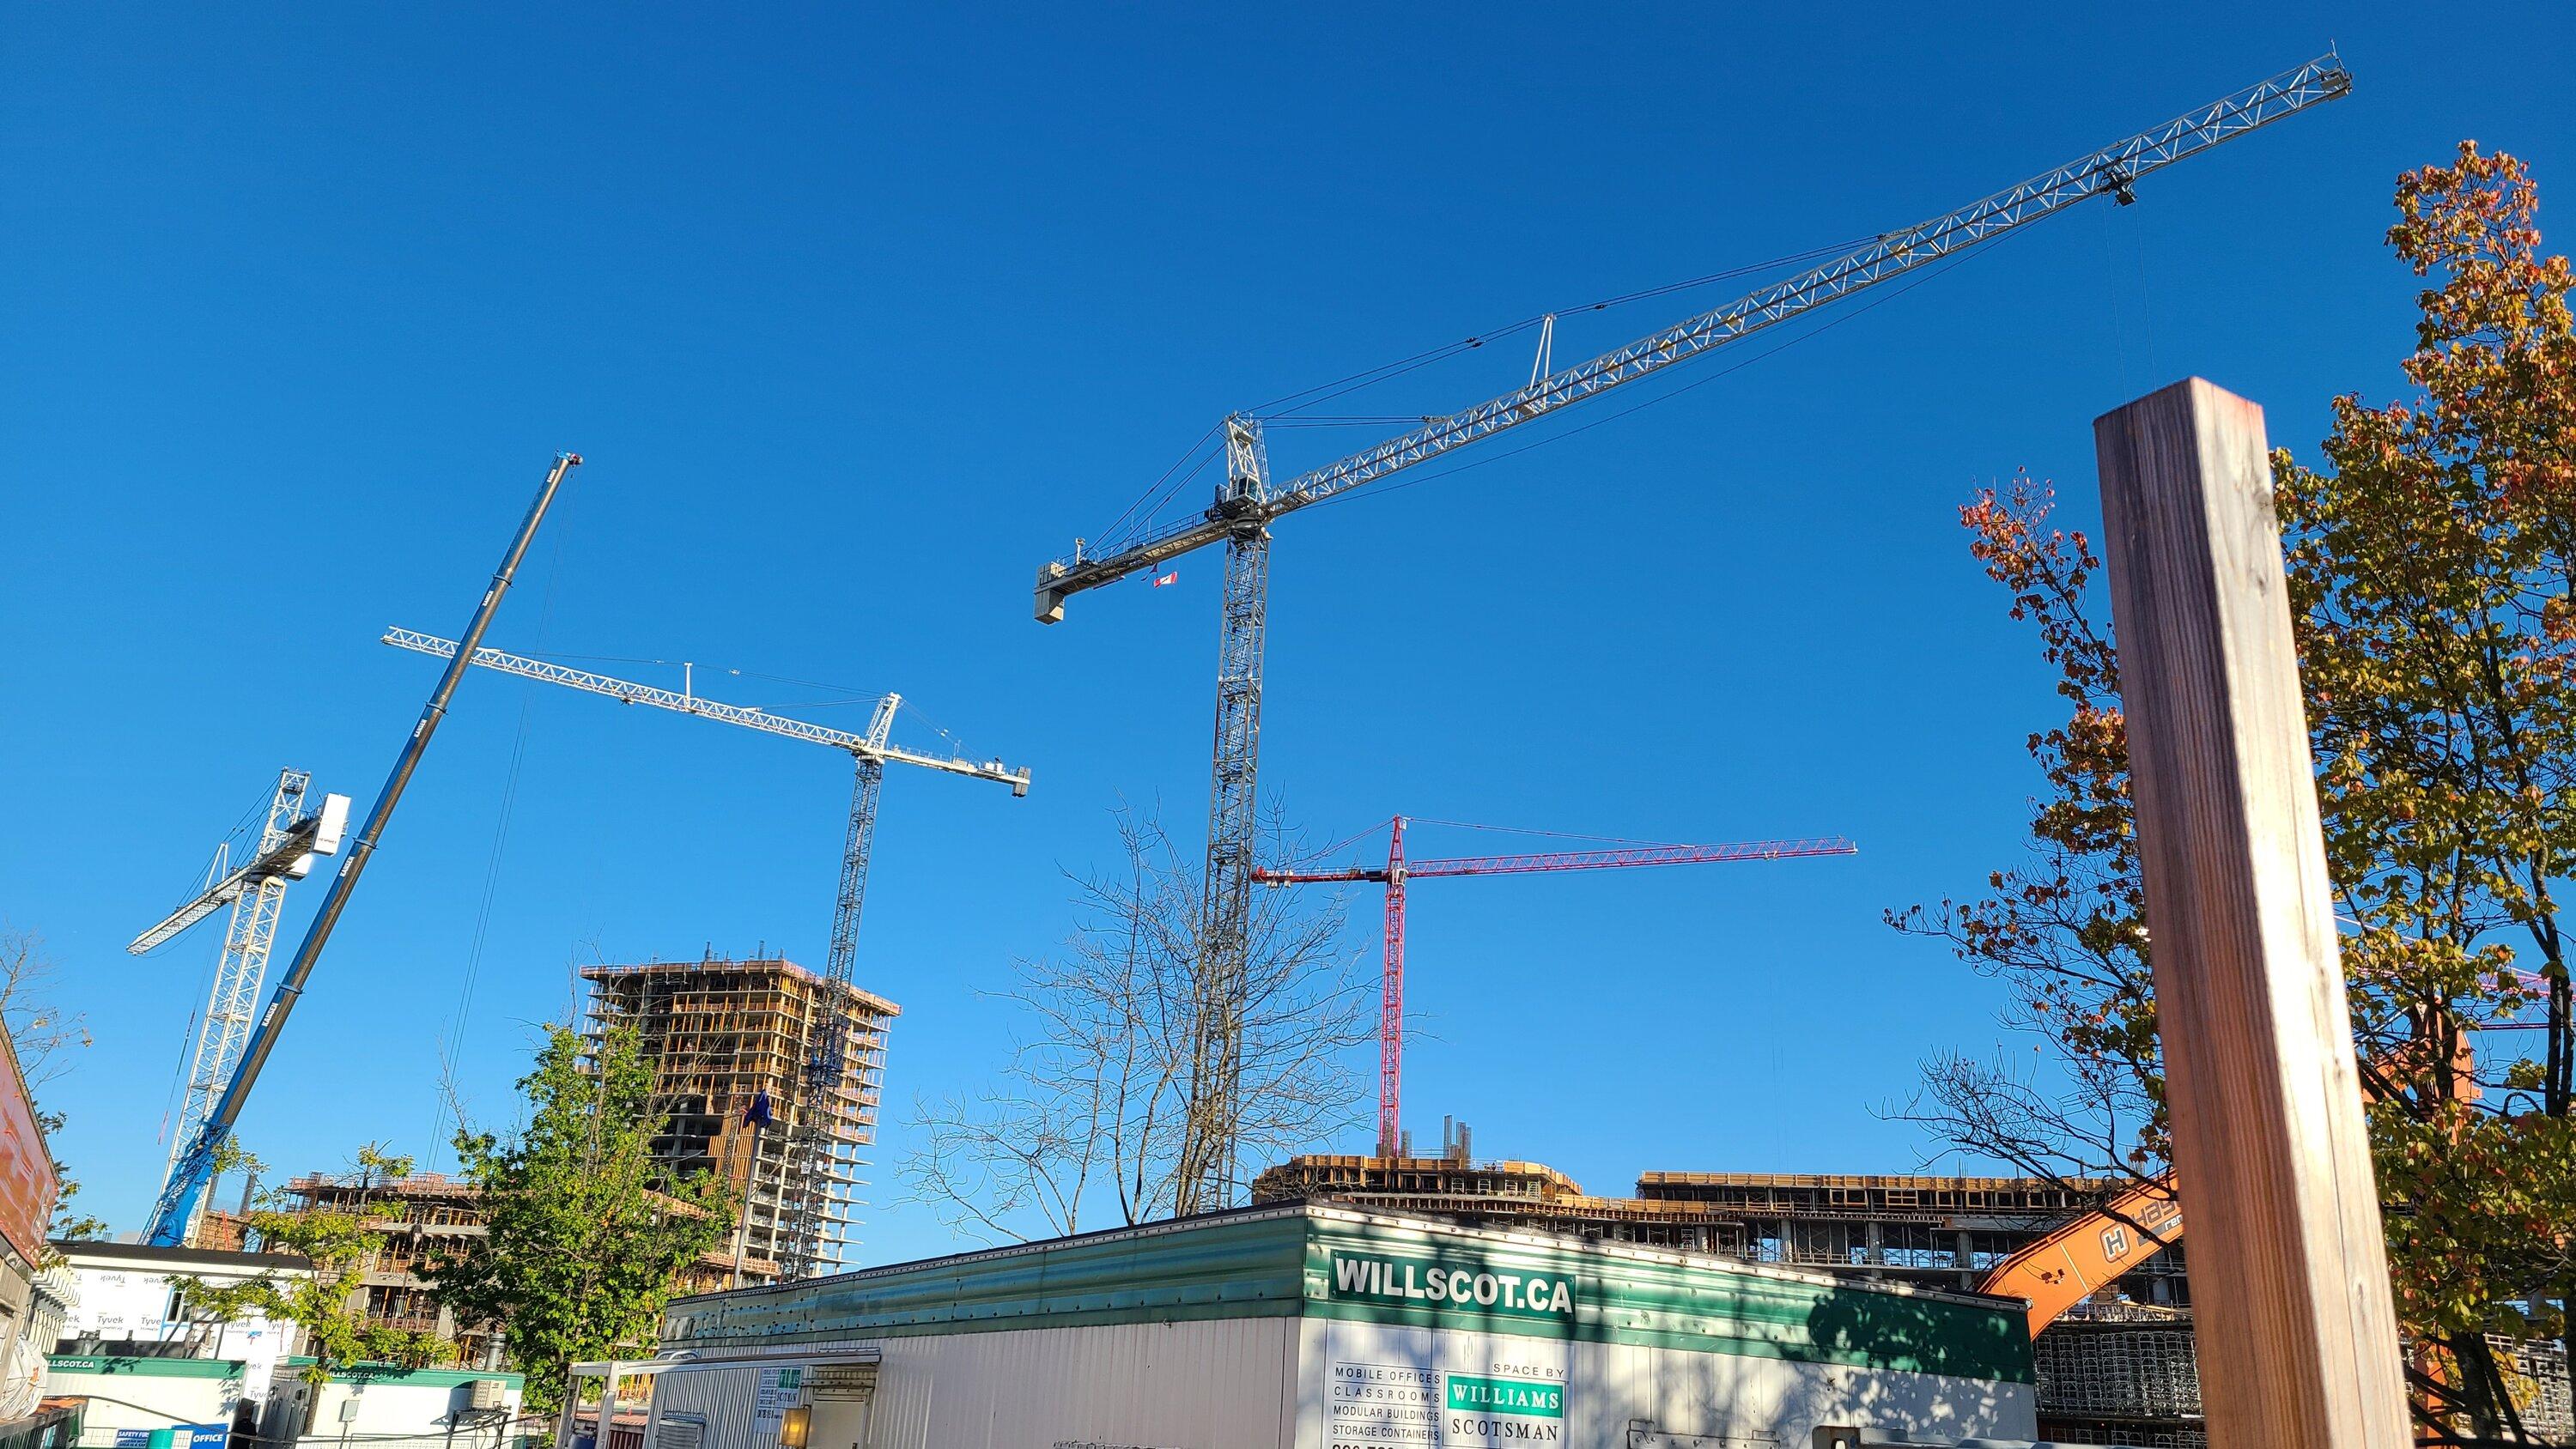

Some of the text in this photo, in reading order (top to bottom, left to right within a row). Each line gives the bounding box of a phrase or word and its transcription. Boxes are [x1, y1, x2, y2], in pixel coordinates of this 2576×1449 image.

[1335, 1258, 1572, 1313] WILLSCOT.CA
[97, 1314, 124, 1325] Tyvek
[141, 1317, 161, 1325] Tyve
[268, 1321, 283, 1330] Tyv
[47, 1360, 94, 1368] LLSCOT.CA
[1493, 1363, 1564, 1378] SPACE BY
[329, 1371, 374, 1379] ILLSCOT.CA
[1335, 1367, 1440, 1384] MOBILE OFFICES
[1334, 1385, 1440, 1403] CLASSROOMS
[1452, 1384, 1559, 1410] WILLIAMS
[1334, 1405, 1439, 1422] MODULAR BUILDINGS
[1333, 1425, 1439, 1441] STORAGE CONTAINERS
[1452, 1418, 1558, 1440] SCOTSMAN
[193, 1434, 223, 1443] OFFICE
